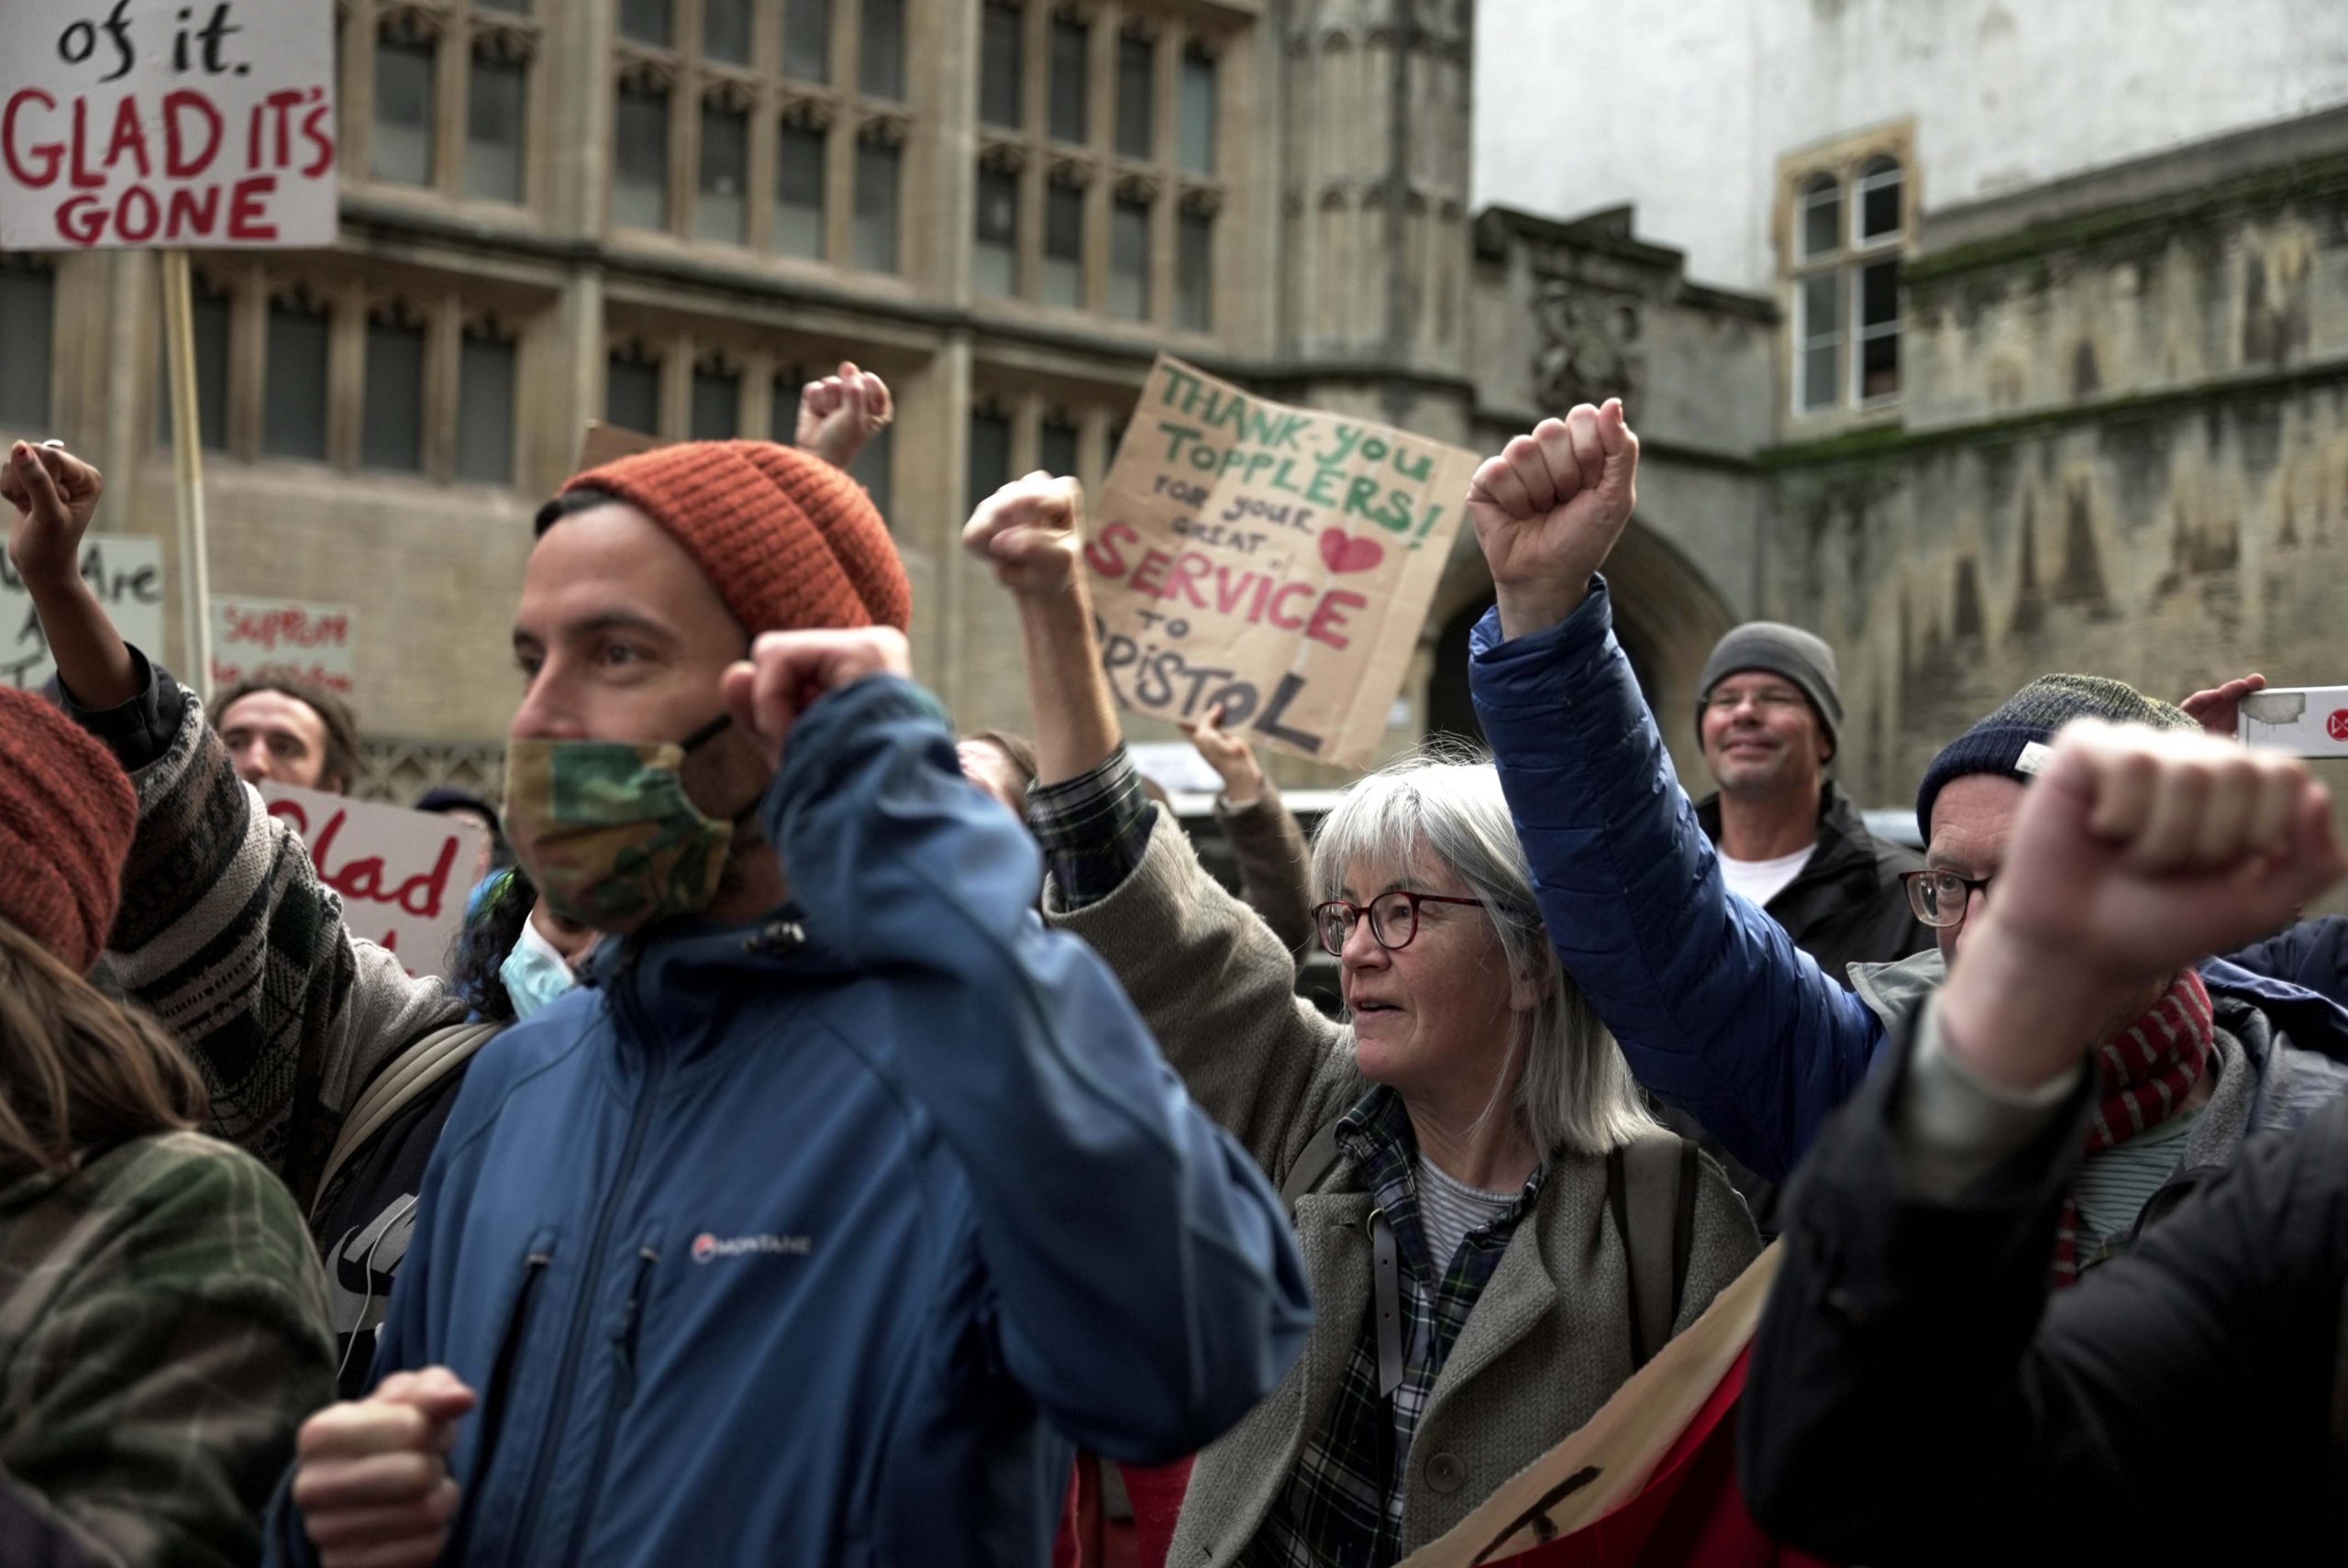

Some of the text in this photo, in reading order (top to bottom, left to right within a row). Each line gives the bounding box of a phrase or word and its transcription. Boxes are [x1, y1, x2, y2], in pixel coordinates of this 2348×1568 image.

[58, 0, 250, 83] of it.
[3, 87, 335, 190] GLAD IT'S
[55, 175, 279, 247] GONE
[1086, 523, 1368, 650] SERVICE
[1136, 609, 1189, 637] TO
